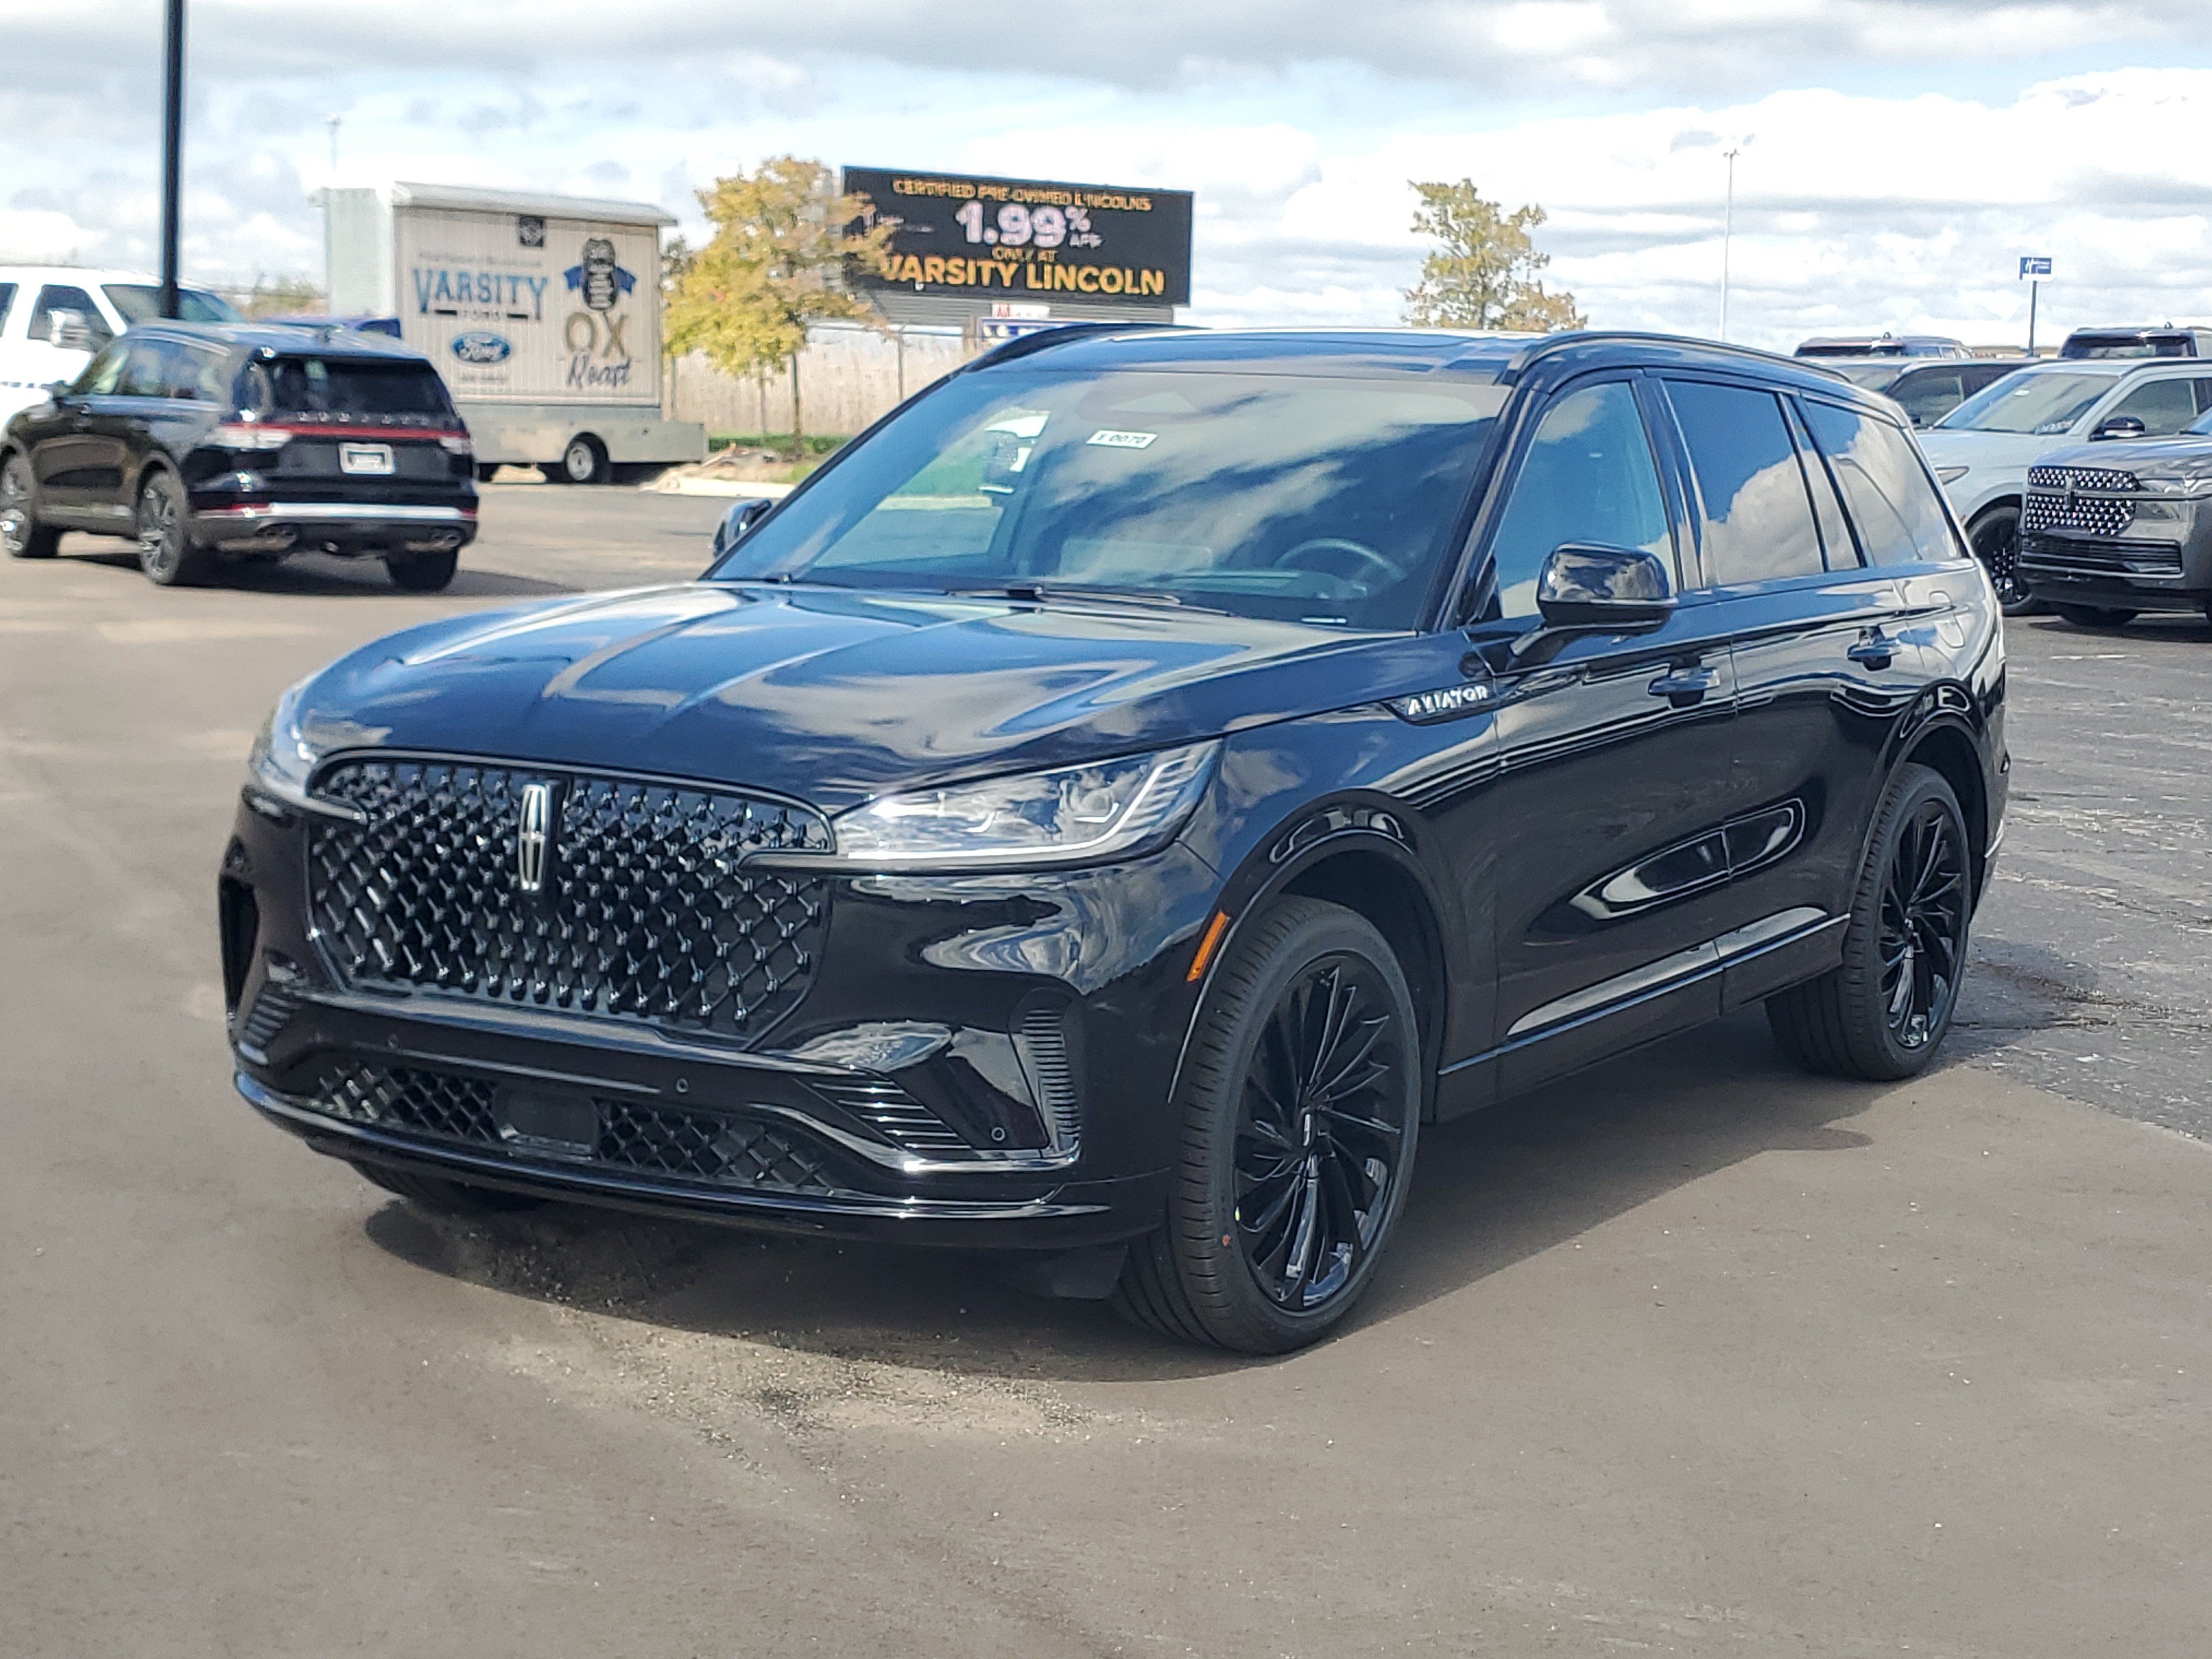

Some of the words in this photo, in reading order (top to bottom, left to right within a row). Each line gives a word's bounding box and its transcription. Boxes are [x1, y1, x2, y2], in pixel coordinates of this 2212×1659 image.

[893, 178, 976, 199] CERTIFIED
[414, 268, 547, 320] VARSITY
[881, 253, 1019, 288] VARSITY
[1026, 263, 1164, 296] LINCOLN
[565, 312, 629, 357] OX
[1408, 685, 1488, 715] AVIATOR
